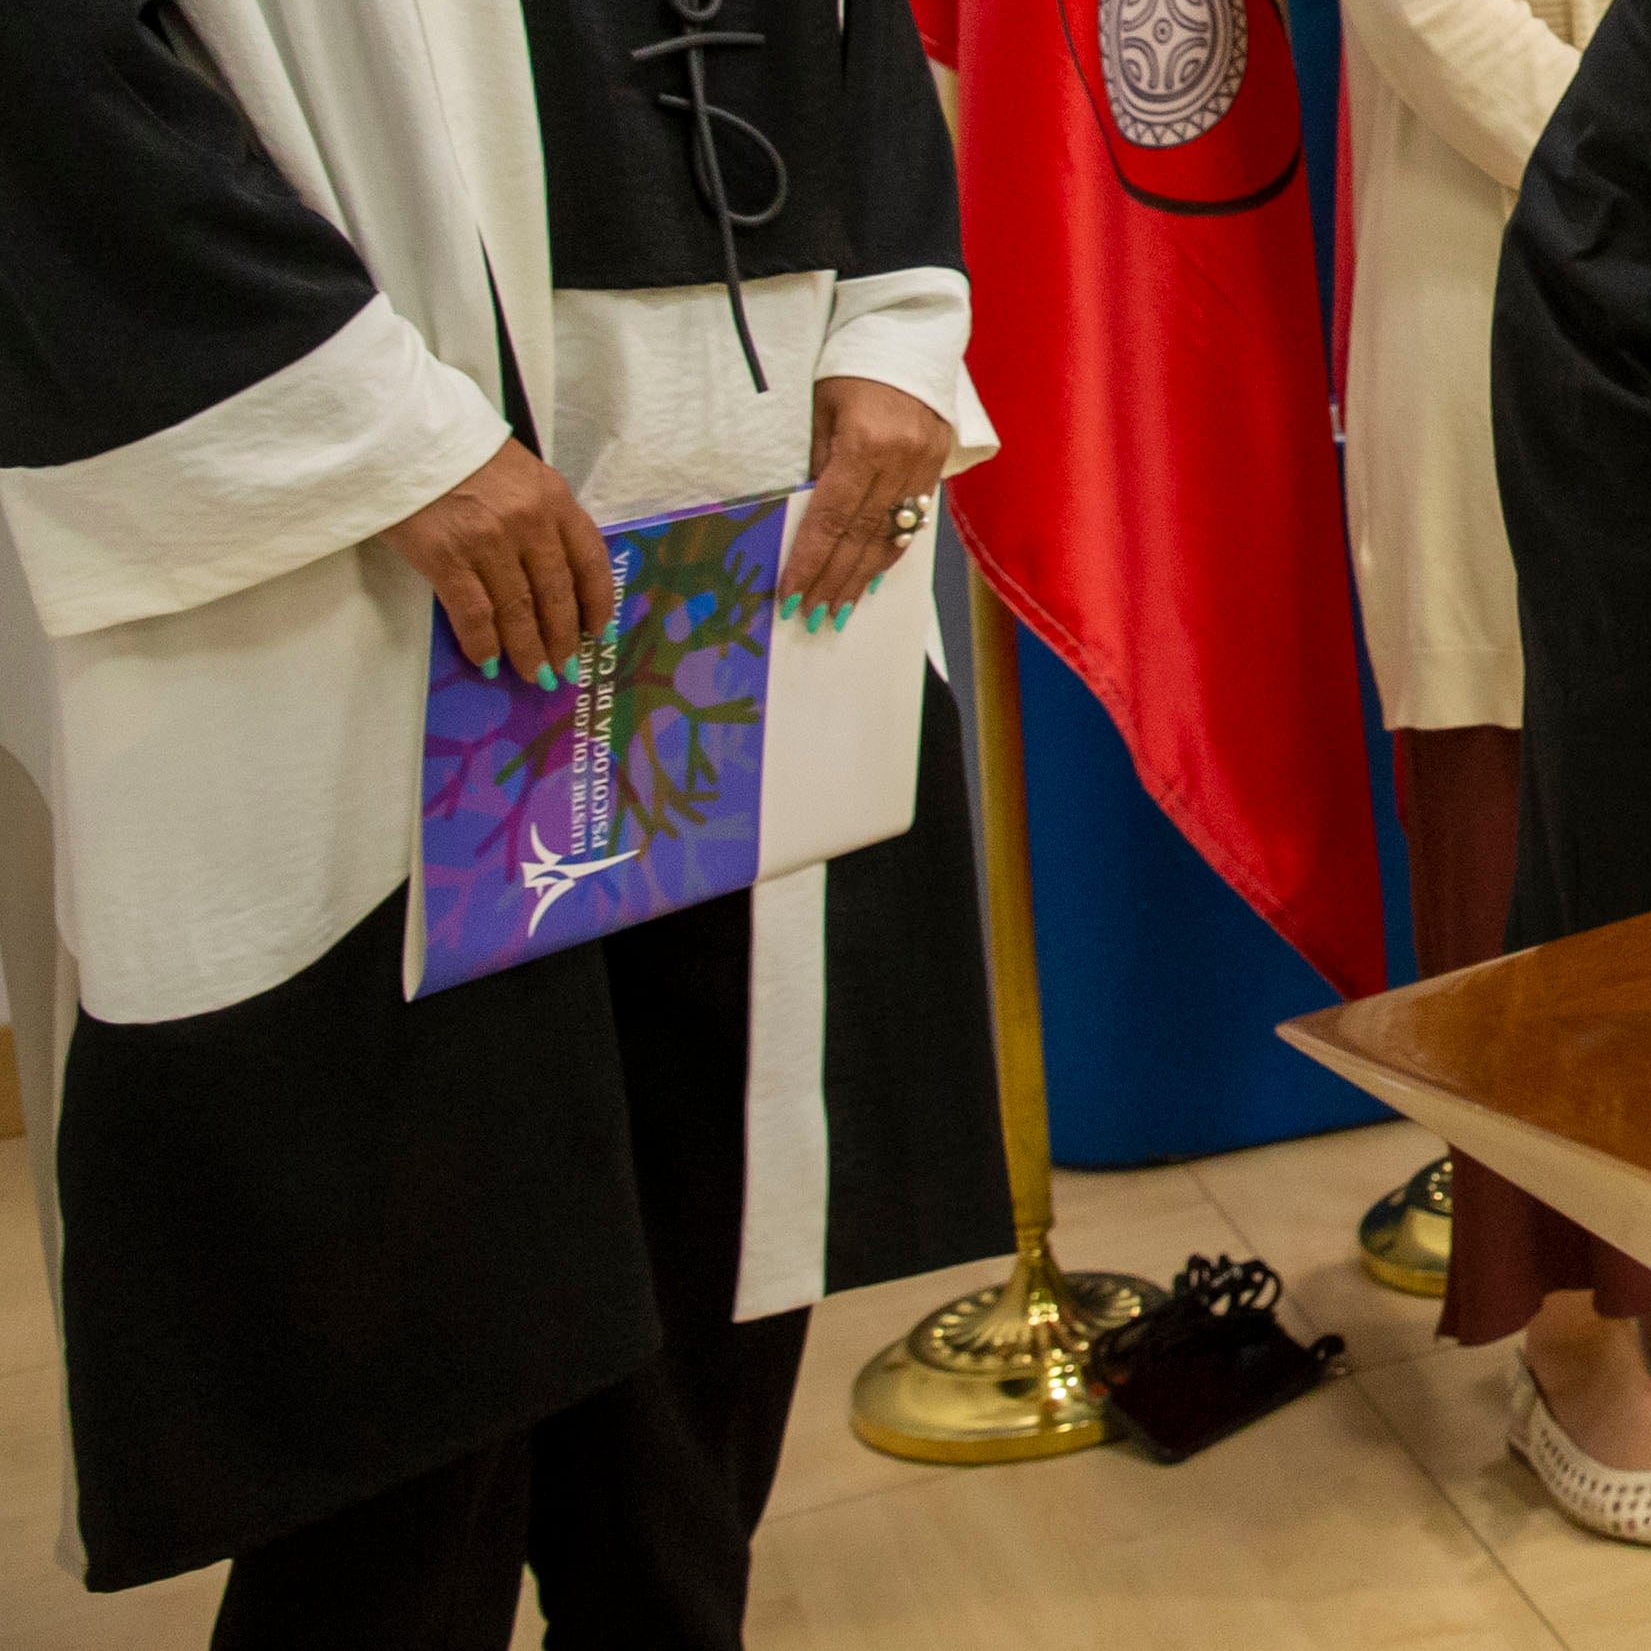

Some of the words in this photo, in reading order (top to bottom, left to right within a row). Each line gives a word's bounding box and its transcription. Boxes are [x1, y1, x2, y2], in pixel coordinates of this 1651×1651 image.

[572, 693, 591, 774] COLEGIO
[596, 680, 615, 711] DE
[570, 778, 587, 855] ILUSTRE
[589, 717, 612, 848] PSICOLOGÍA
